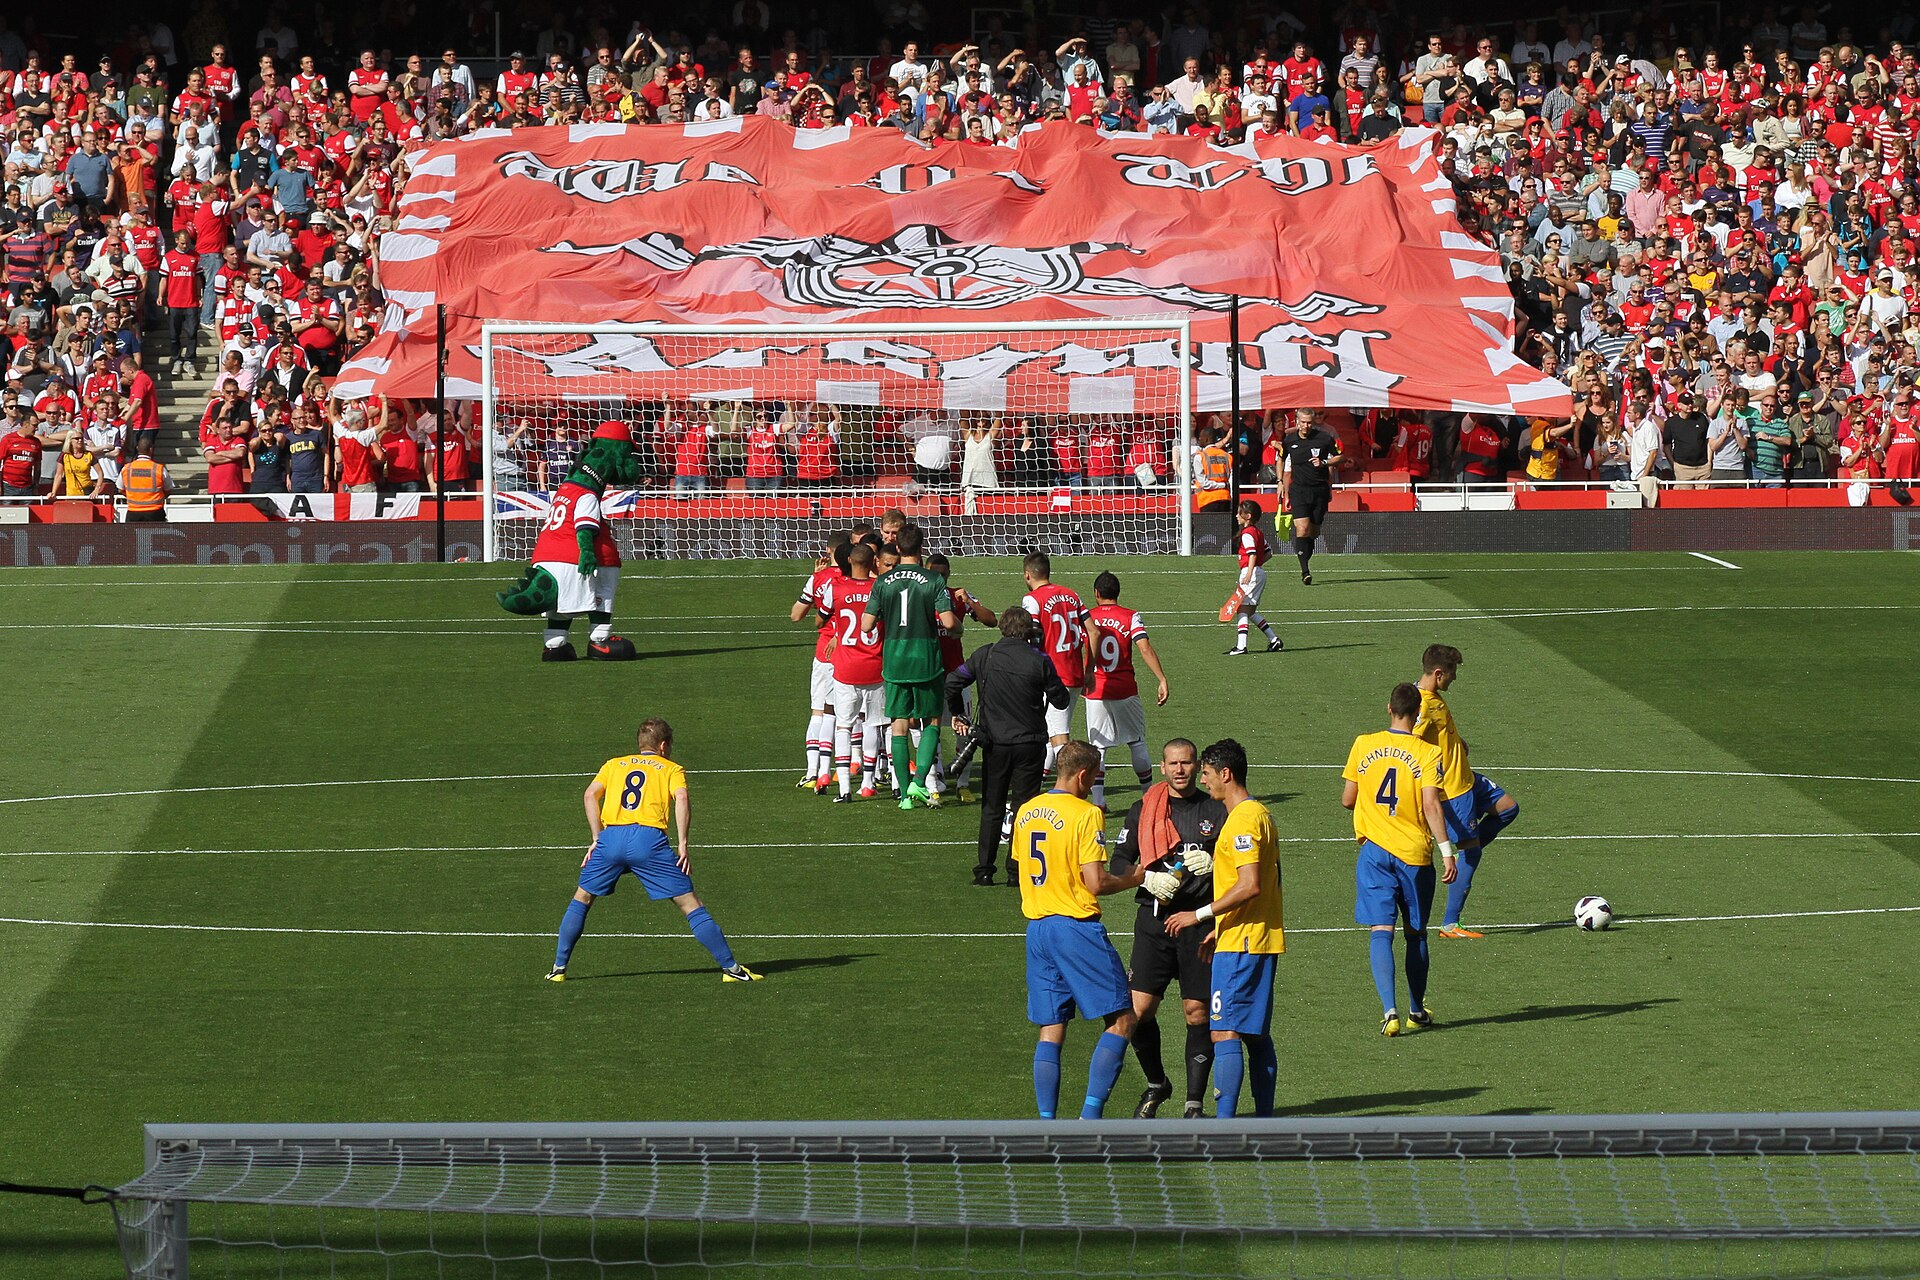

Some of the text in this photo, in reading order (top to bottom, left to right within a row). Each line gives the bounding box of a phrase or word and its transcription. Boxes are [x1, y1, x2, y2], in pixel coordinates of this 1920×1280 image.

[289, 441, 316, 454] UCLA
[1417, 440, 1429, 460] 19
[289, 492, 397, 518] A F
[884, 570, 928, 585] SZCZESNY
[814, 582, 829, 599] VER
[844, 594, 870, 605] GIBB
[899, 588, 908, 627] 1
[1043, 594, 1081, 614] JENKINSON
[1051, 610, 1080, 653] 25
[1094, 618, 1130, 638] AZORLA
[1095, 635, 1119, 673] 9
[631, 757, 665, 771] DAVIS
[1357, 747, 1422, 780] SCHNEIDERLIN
[621, 770, 646, 810] 8
[1375, 767, 1399, 816] 4
[1018, 807, 1065, 831] HOOIVELD
[1029, 830, 1048, 886] 5
[1211, 990, 1221, 1013] 6
